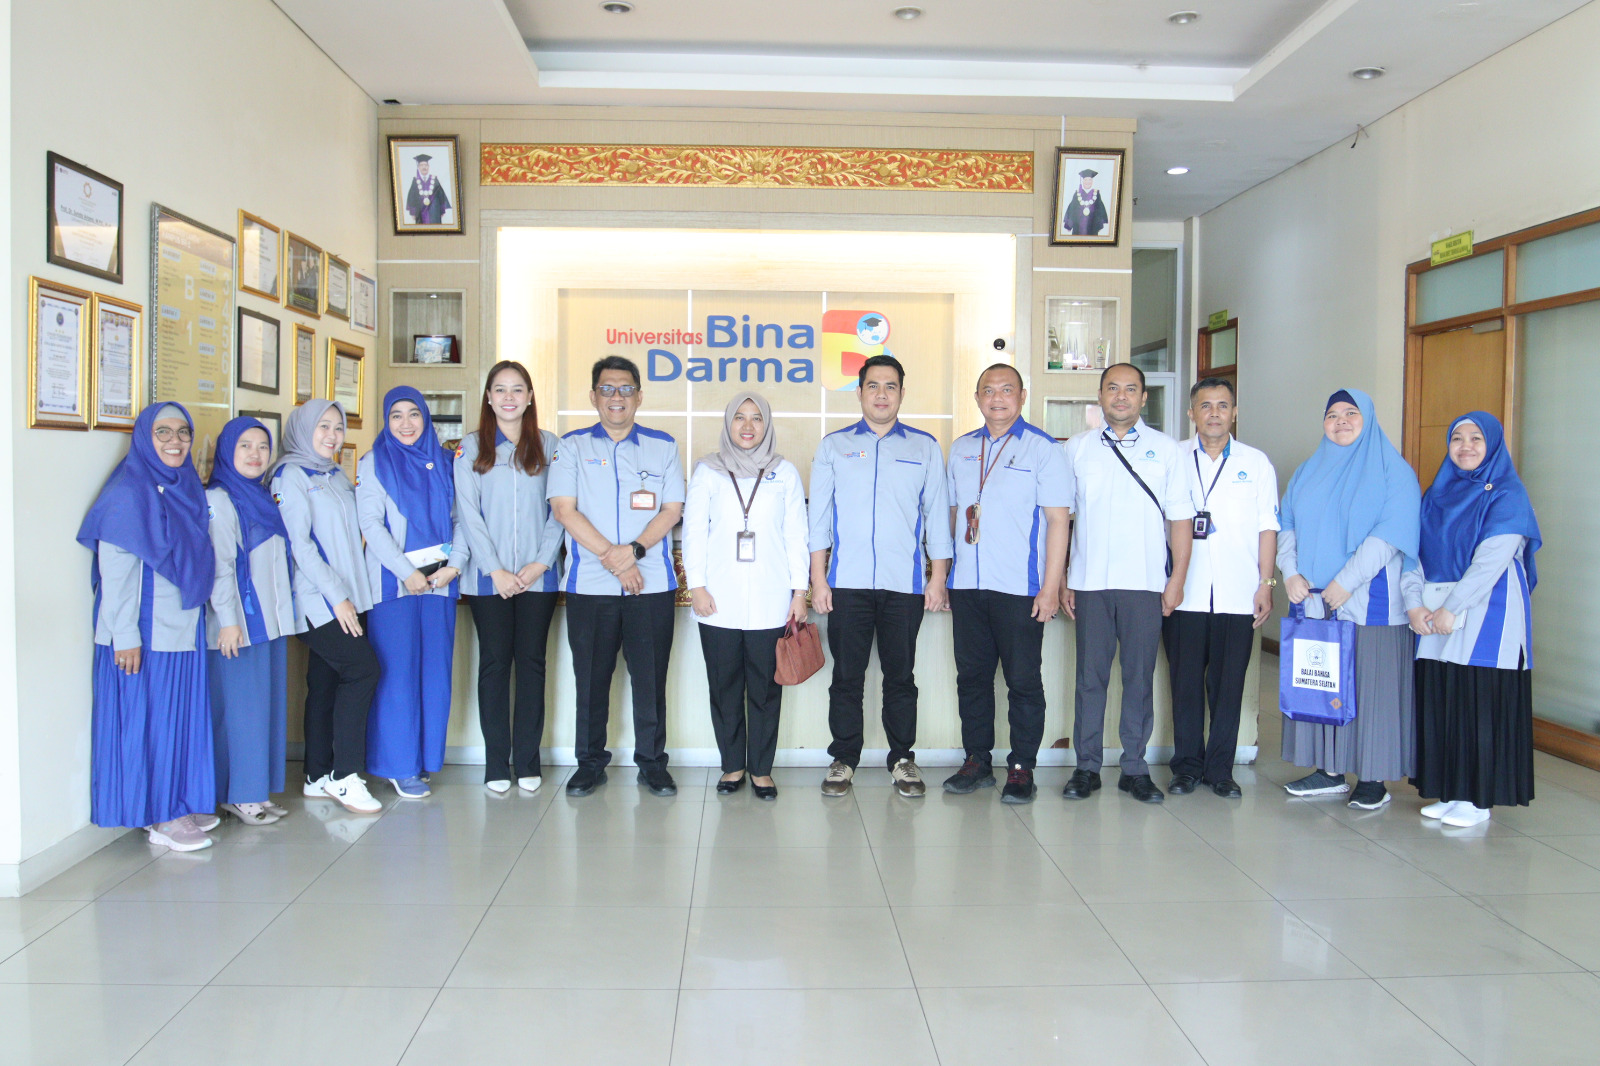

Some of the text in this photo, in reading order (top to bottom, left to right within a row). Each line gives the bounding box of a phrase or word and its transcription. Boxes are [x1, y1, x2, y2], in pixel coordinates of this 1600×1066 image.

[185, 274, 195, 300] B
[186, 320, 193, 346] 1
[606, 314, 814, 349] Universitas Bina
[222, 351, 229, 375] 6
[647, 348, 814, 383] Darma
[1295, 677, 1336, 688] SUMATERA SELATAN
[1301, 668, 1330, 678] BALAI BAHASA
